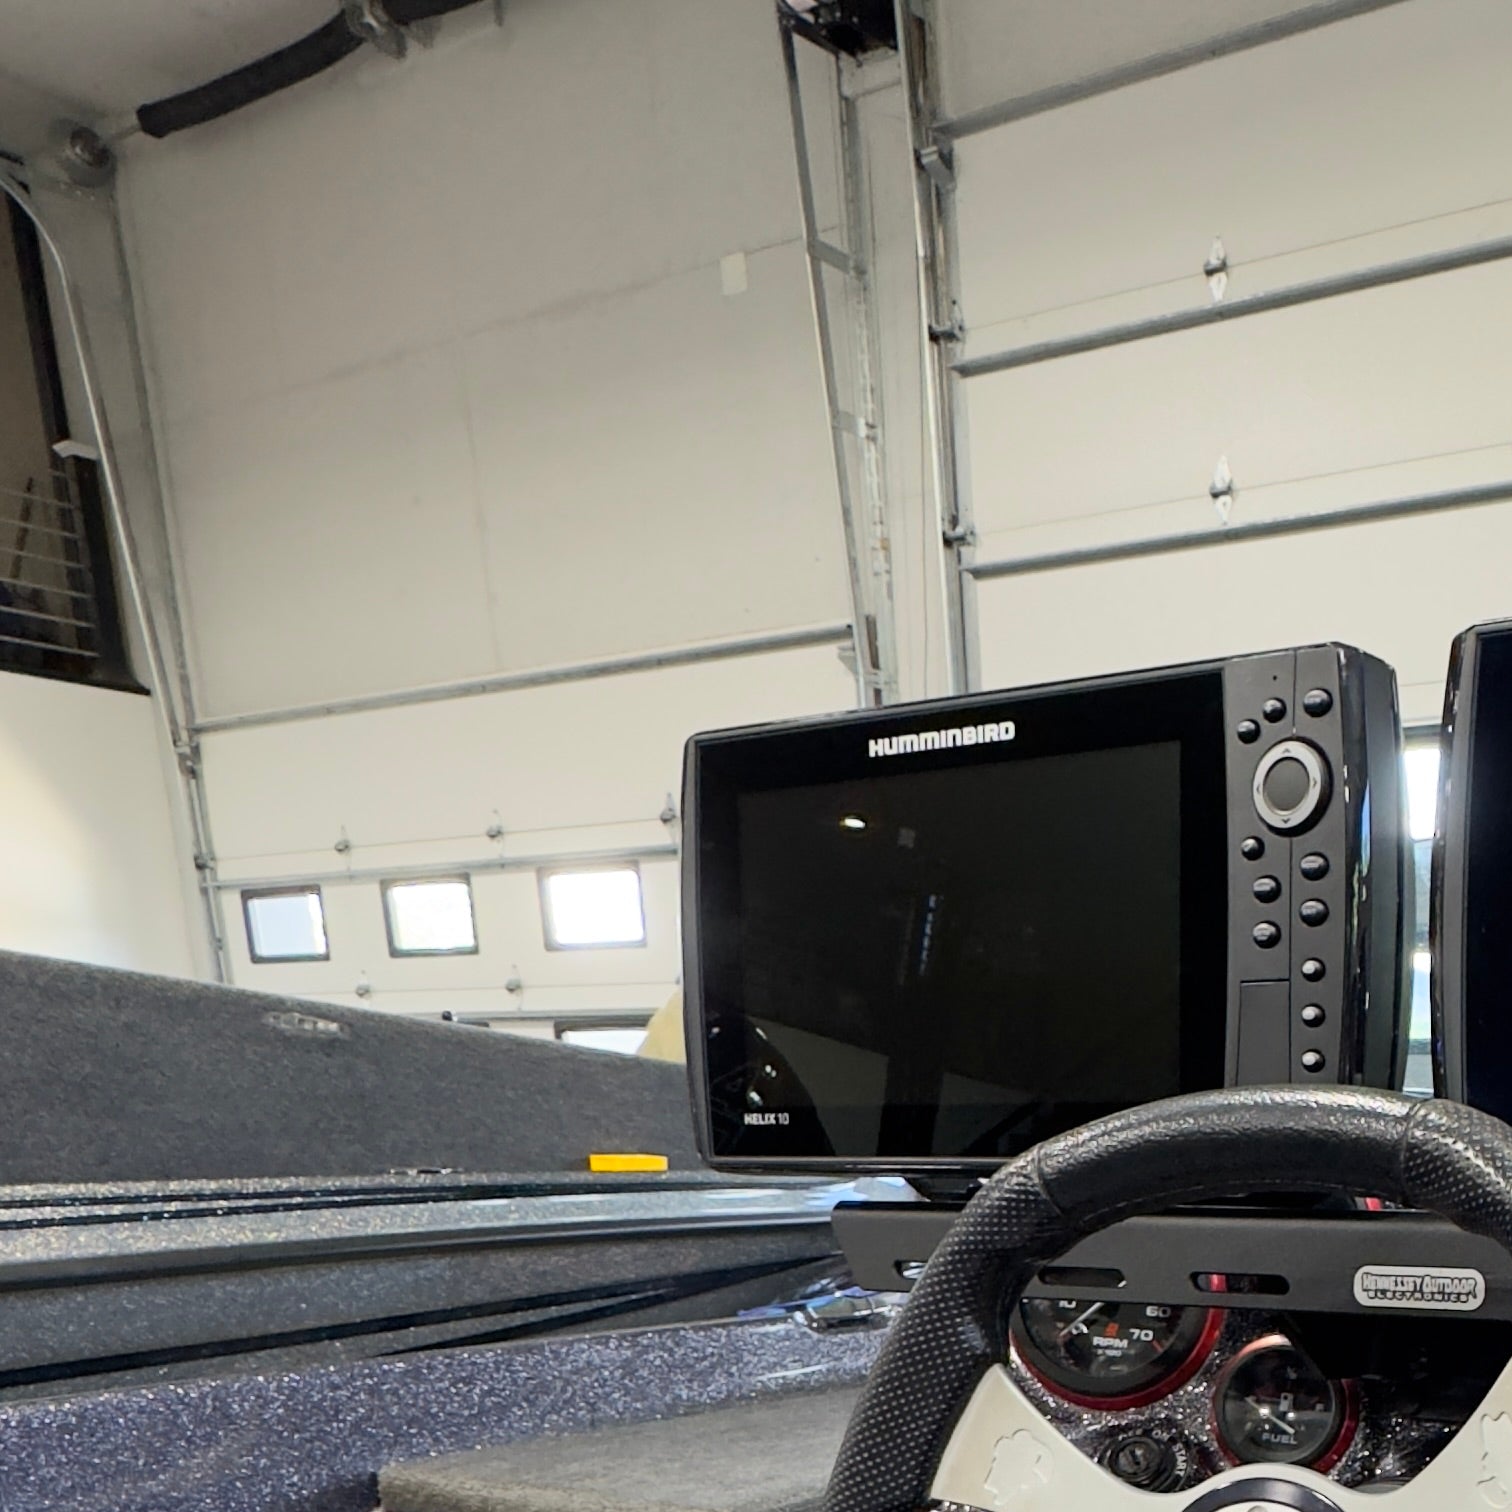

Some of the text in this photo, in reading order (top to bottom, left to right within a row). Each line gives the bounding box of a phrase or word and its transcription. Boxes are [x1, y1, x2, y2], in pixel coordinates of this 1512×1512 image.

[868, 720, 1016, 758] HUMMINBIRD
[743, 1112, 790, 1126] HELIX 10
[1145, 1305, 1171, 1318] 60
[1129, 1328, 1154, 1342] 70
[1092, 1336, 1128, 1349] RPM
[1262, 1432, 1298, 1446] FUEL
[1172, 1443, 1188, 1477] START
